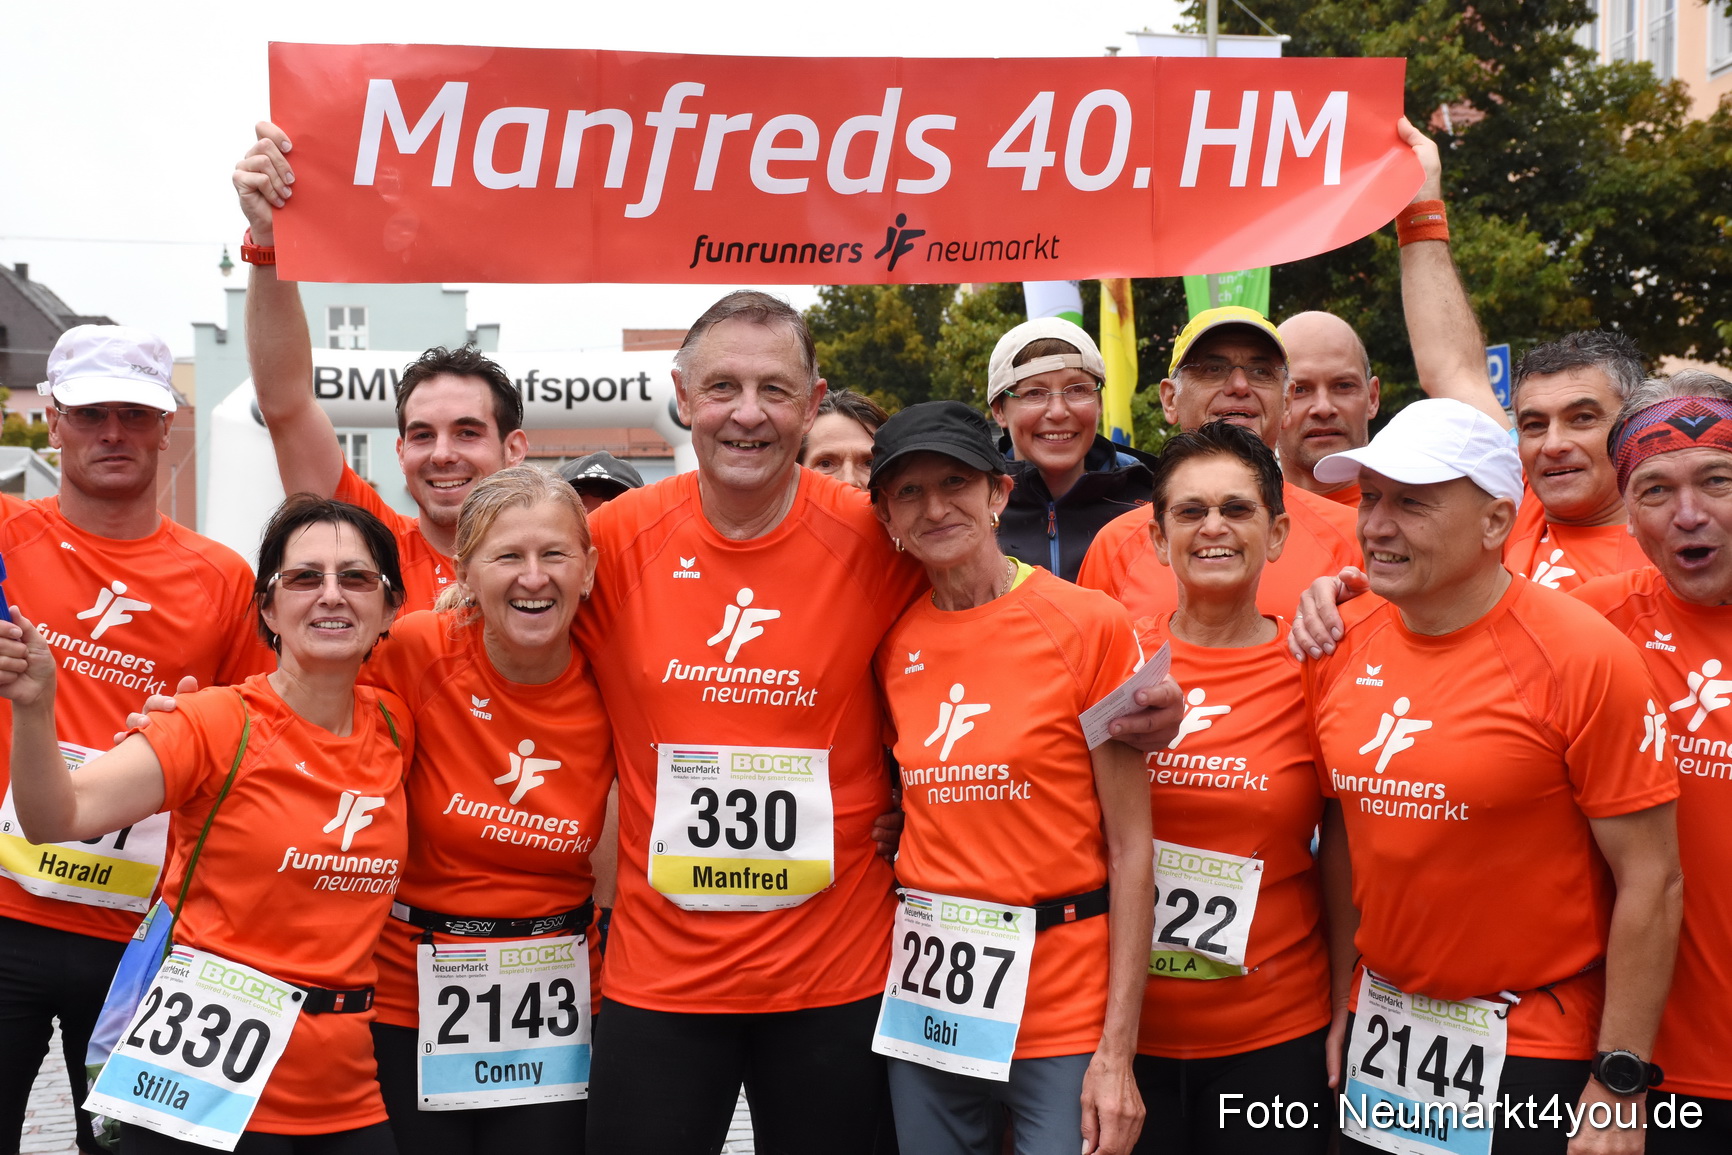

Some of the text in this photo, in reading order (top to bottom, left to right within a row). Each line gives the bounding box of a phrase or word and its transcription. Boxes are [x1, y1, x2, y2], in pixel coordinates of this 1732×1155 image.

[353, 79, 1348, 219] Manfreds 40. HM
[690, 233, 1060, 270] funrunners neumarkt
[516, 369, 652, 409] fsport
[673, 570, 700, 578] erima
[1645, 640, 1676, 652] erima
[63, 656, 166, 695] neumarkt
[662, 659, 800, 686] funrunners
[904, 662, 924, 675] erima
[1356, 677, 1384, 687] erima
[702, 686, 818, 707] neumarkt
[671, 764, 720, 774] NeuerMarkt
[731, 753, 812, 775] BOCK
[1146, 751, 1247, 771] runners
[757, 774, 766, 782] by
[901, 764, 1009, 790] funrunners
[1147, 770, 1269, 791] neumarkt
[1332, 768, 1445, 800] funrunners
[928, 780, 1031, 804] neumarkt
[443, 793, 579, 836] funrunners
[687, 787, 797, 852] 330
[1360, 797, 1469, 821] neumarkt
[3, 822, 11, 832] B
[480, 824, 592, 854] neumarkt
[657, 842, 663, 852] D
[38, 852, 113, 886] Harald
[277, 847, 399, 875] funrunners
[1158, 848, 1244, 883] BOCK
[314, 875, 400, 895] neumarkt
[693, 866, 788, 890] Manfred
[1156, 869, 1182, 878] inspired
[1183, 872, 1193, 880] by
[904, 907, 933, 922] NeuerMarkt
[940, 901, 1022, 933] BOCK
[1154, 884, 1237, 955] 22
[940, 923, 960, 931] inspired
[500, 943, 575, 967] BOCK
[432, 963, 488, 973] NeuerMarkt
[500, 967, 525, 975] inspired
[901, 931, 1016, 1010] 2287
[195, 980, 222, 995] inspired
[224, 989, 231, 999] by
[199, 960, 289, 1011] BOCK
[891, 985, 897, 996] A
[1368, 989, 1403, 1009] NeuerMarkt
[437, 978, 579, 1045] 2143
[1411, 994, 1489, 1029] BOCK
[1411, 1012, 1433, 1022] inspired
[1434, 1016, 1441, 1026] by
[126, 986, 271, 1083] 2330
[924, 1016, 958, 1047] Gabi
[425, 1043, 432, 1053] D
[1360, 1014, 1484, 1103] 2144
[475, 1060, 543, 1085] Conny
[1351, 1066, 1357, 1077] B
[133, 1071, 190, 1111] Stilla
